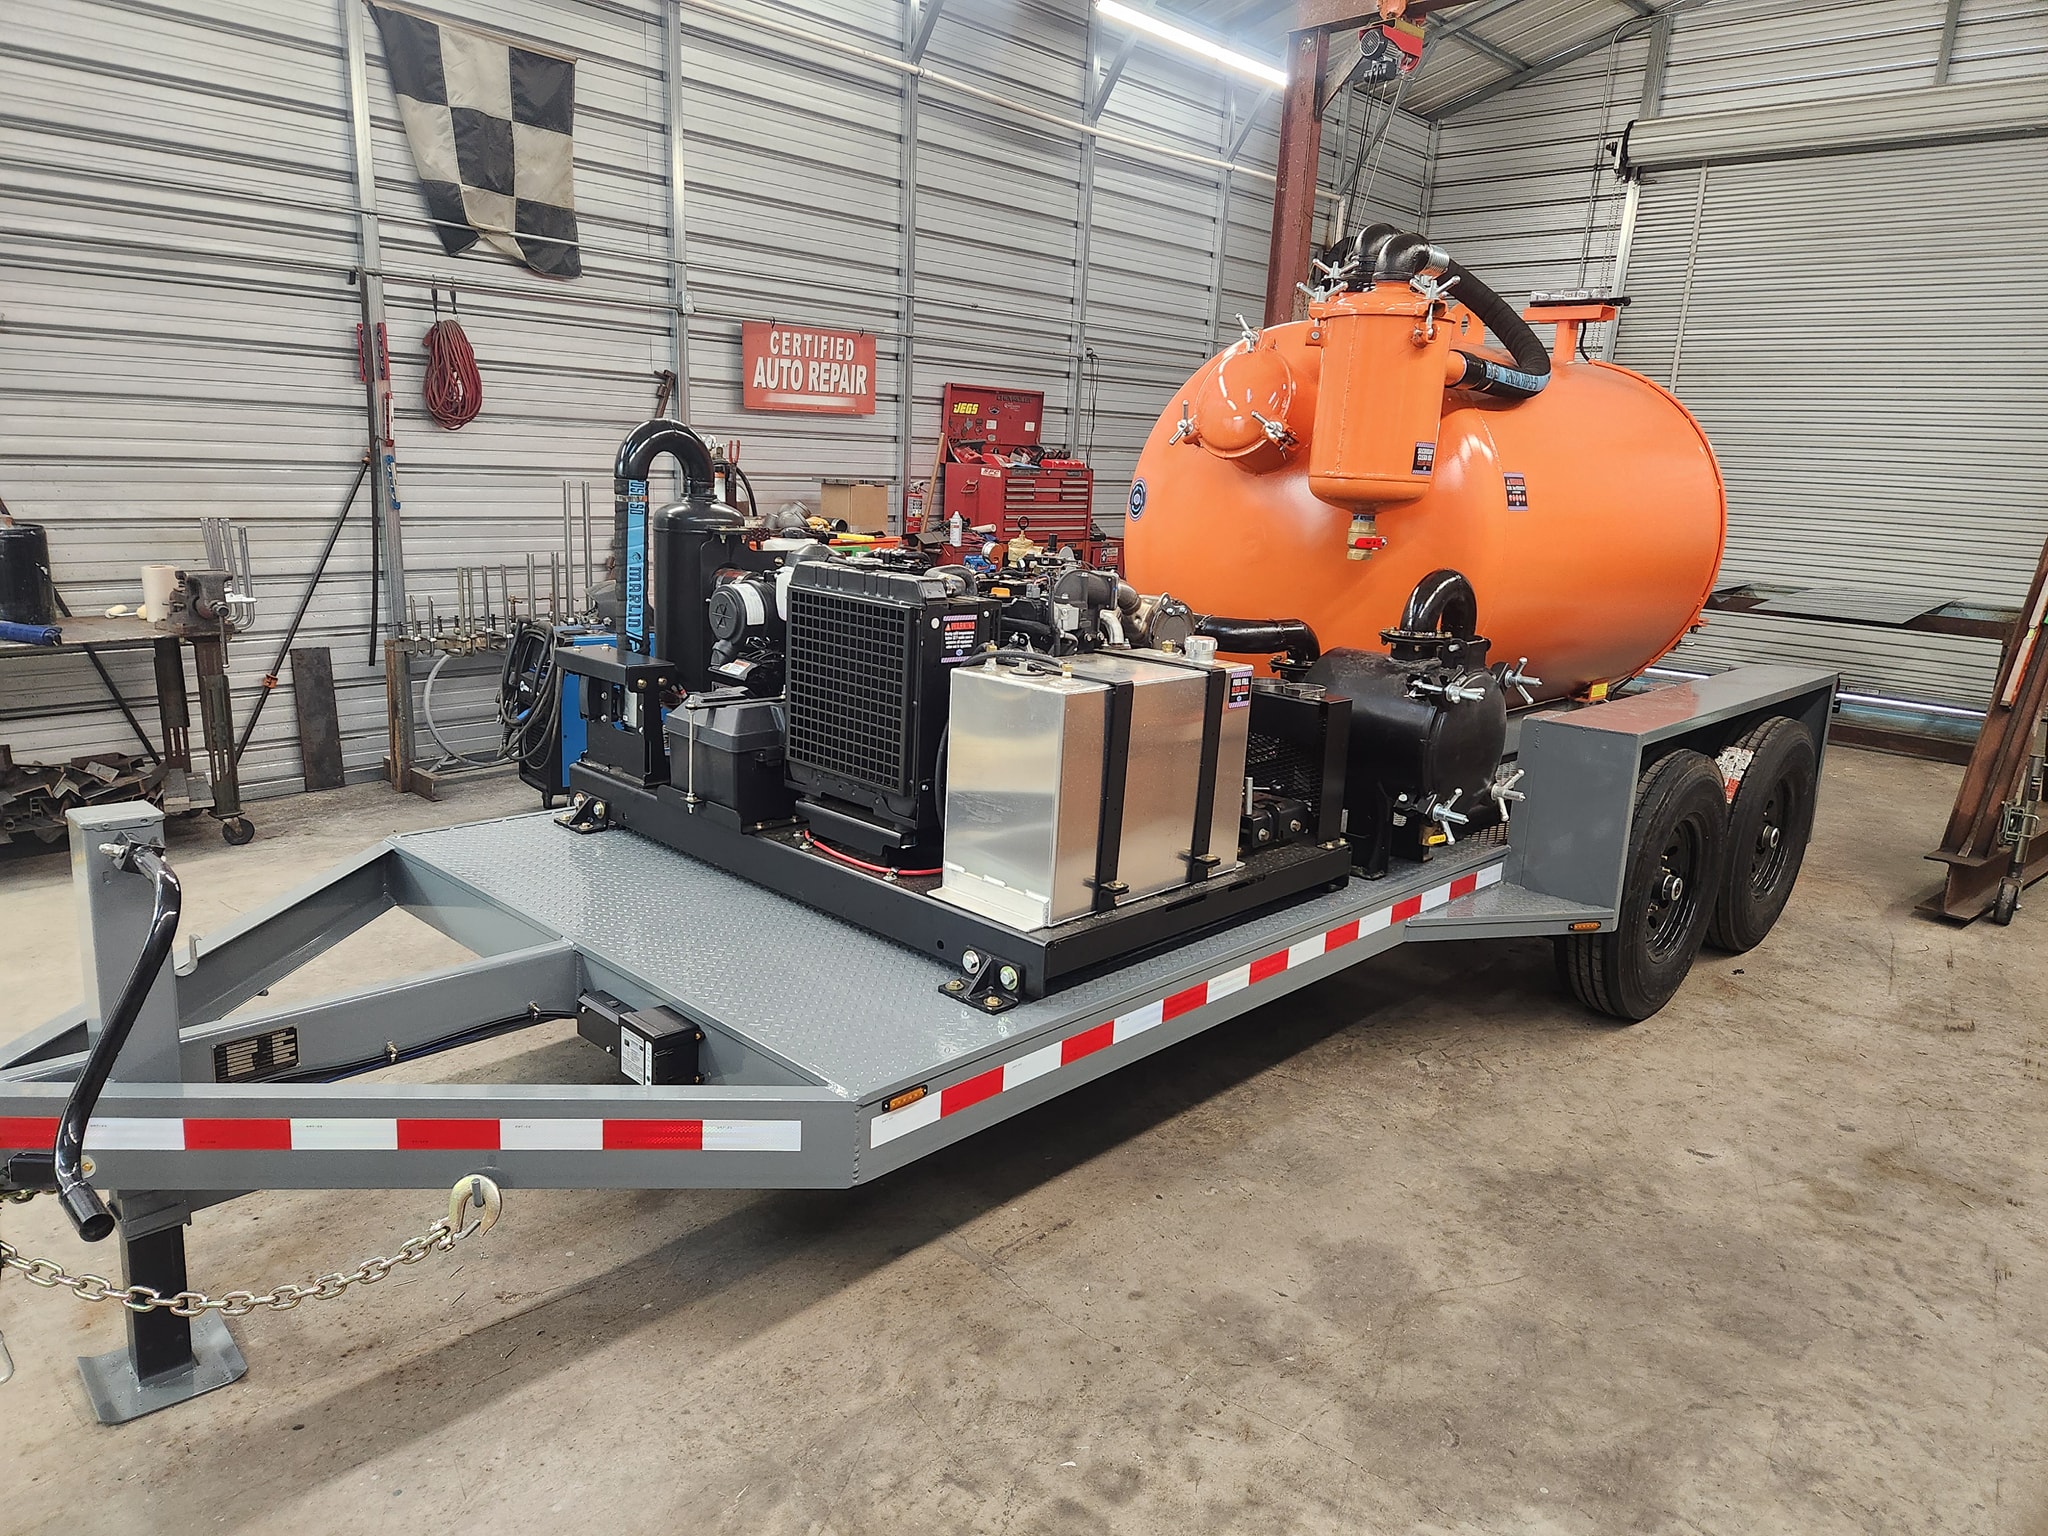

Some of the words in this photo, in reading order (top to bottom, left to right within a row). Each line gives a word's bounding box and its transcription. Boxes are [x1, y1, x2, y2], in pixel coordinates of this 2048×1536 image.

[770, 331, 855, 361] CERTIFIED
[753, 356, 804, 391] AUTO
[808, 360, 867, 395] REPAIR
[953, 403, 979, 415] JEGS
[628, 567, 642, 628] MARLIN
